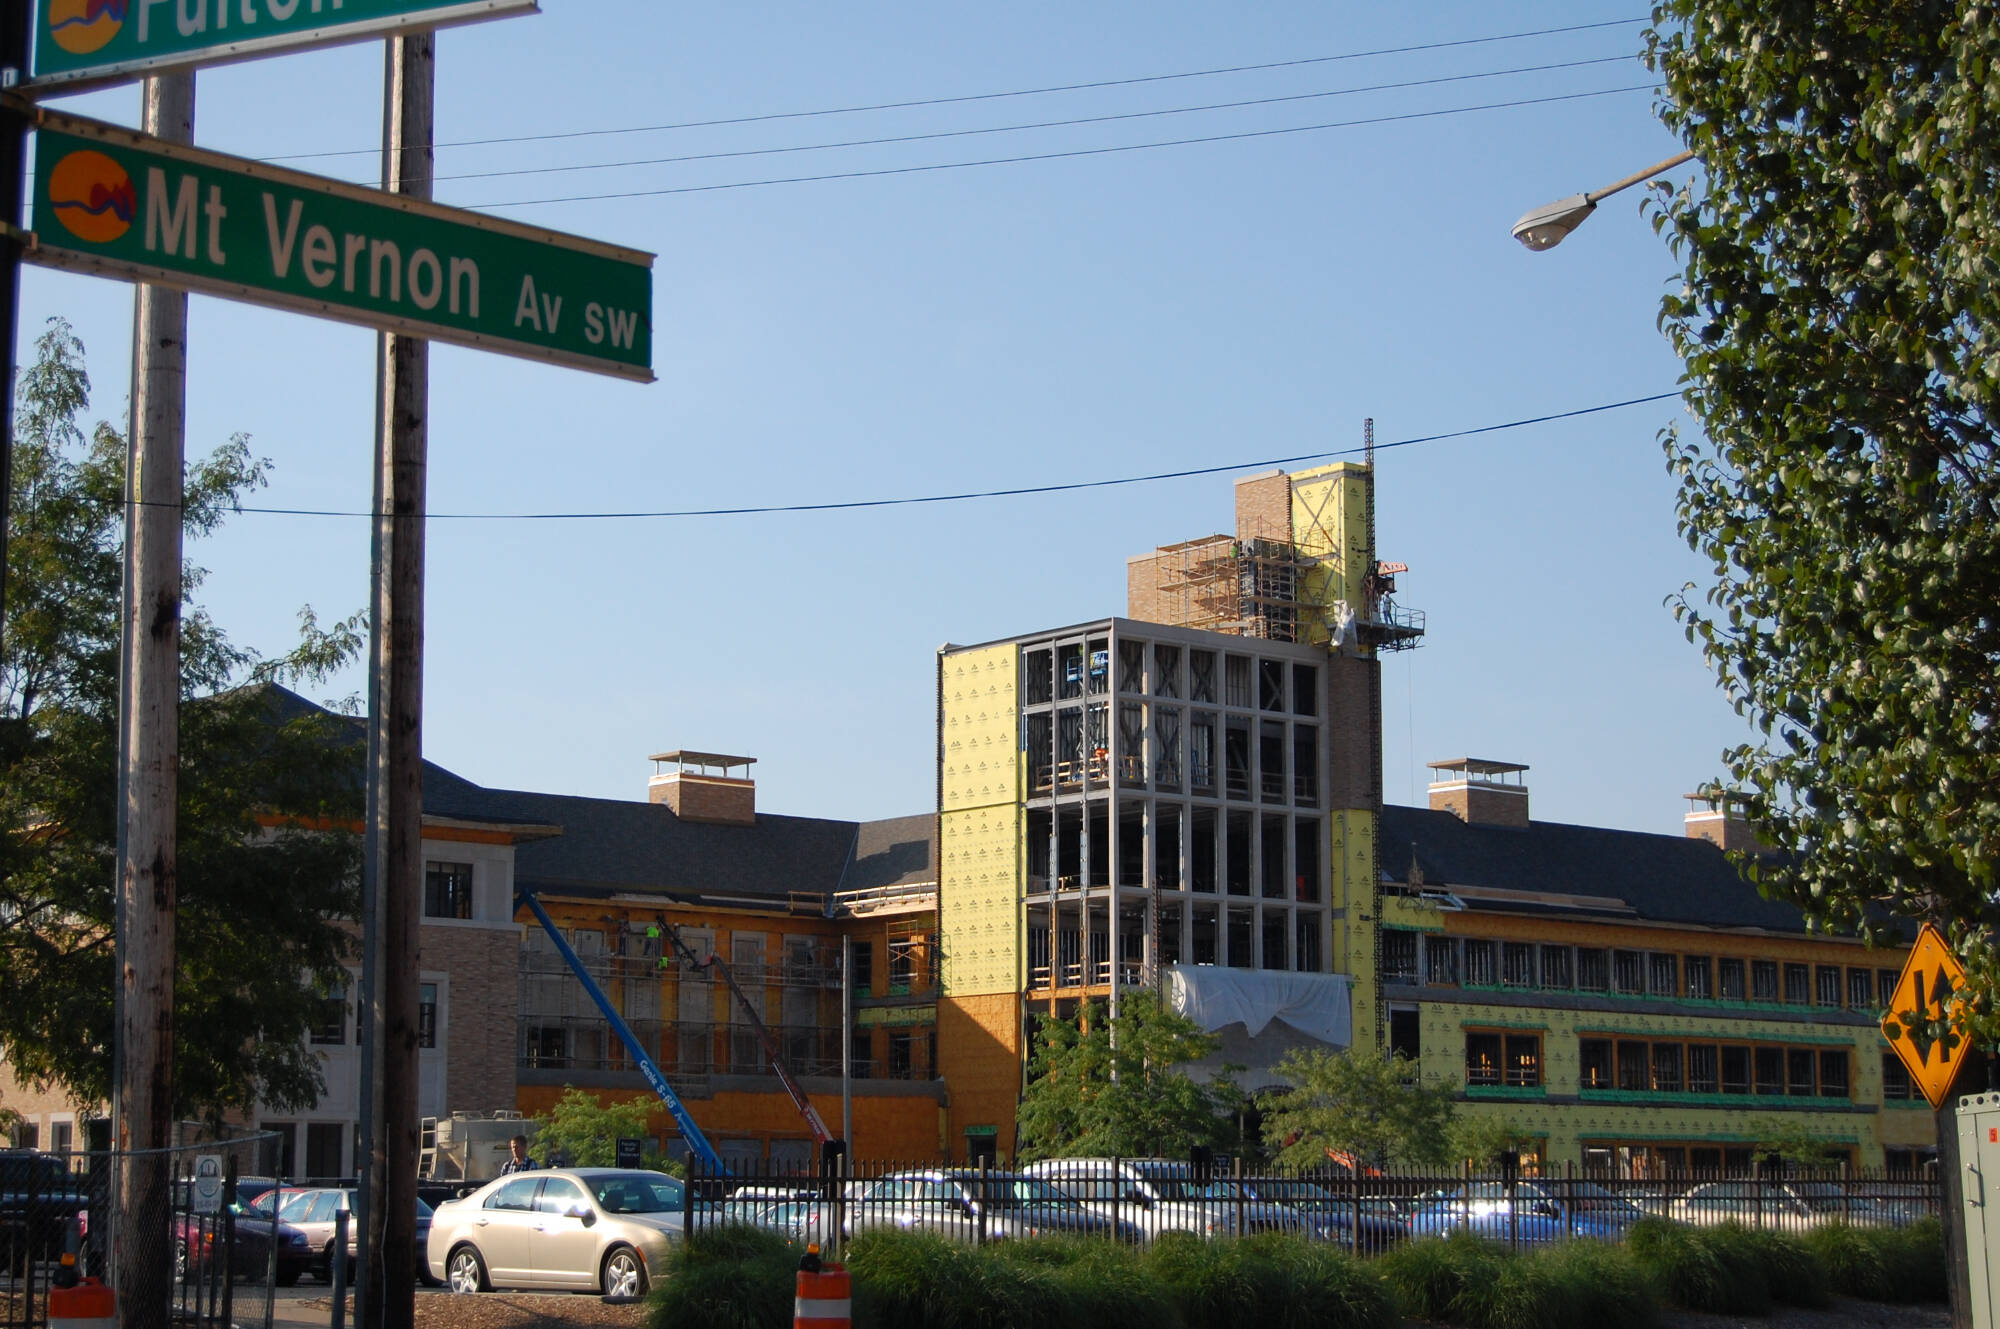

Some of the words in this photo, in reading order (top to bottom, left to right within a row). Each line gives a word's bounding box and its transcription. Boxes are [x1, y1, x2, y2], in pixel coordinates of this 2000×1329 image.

[145, 168, 226, 265] Mt
[263, 192, 480, 318] Vernon
[515, 275, 562, 334] Av
[640, 1060, 657, 1086] Genie
[657, 1084, 677, 1109] S-65
